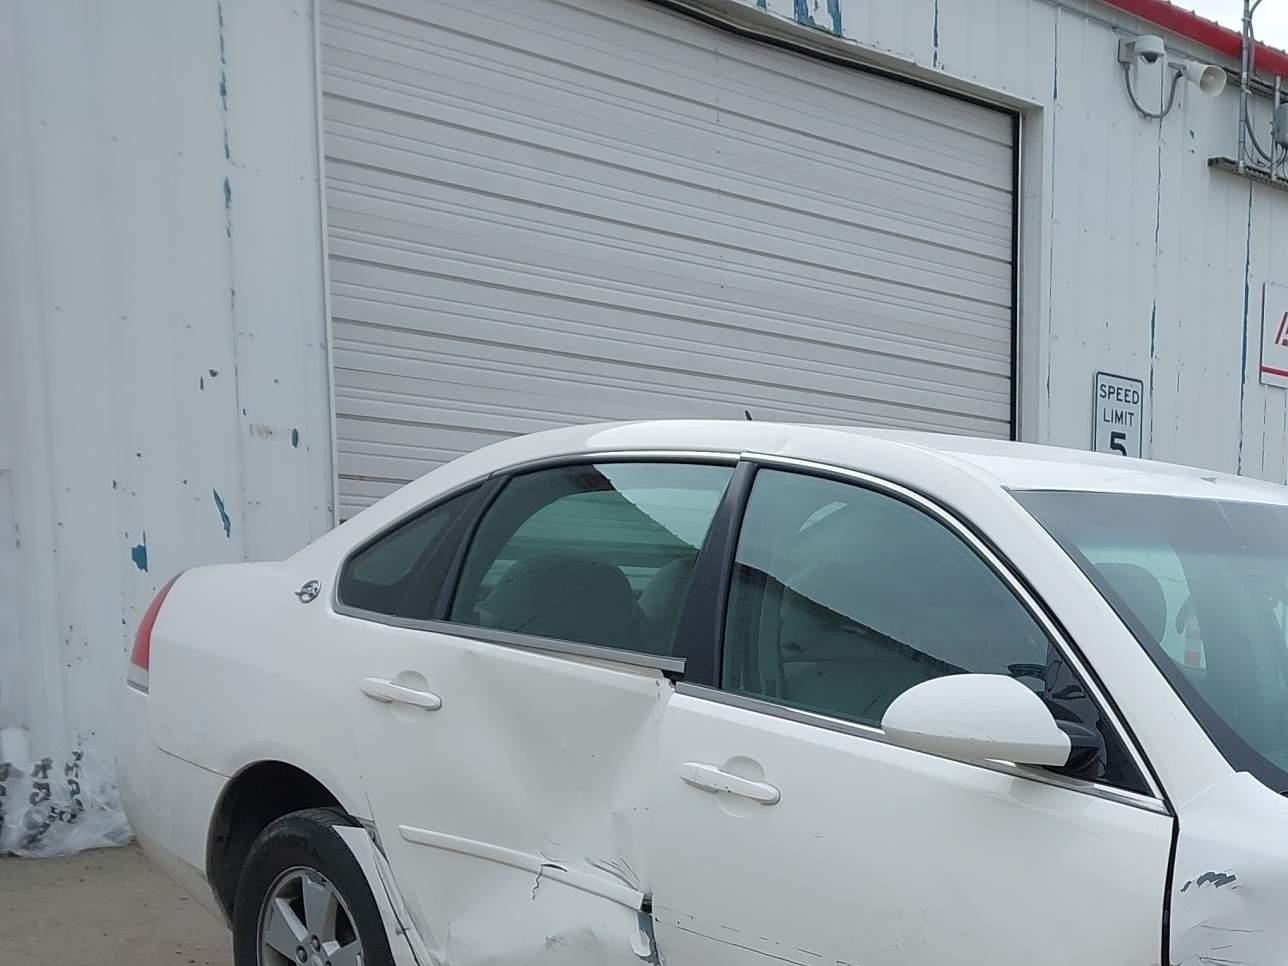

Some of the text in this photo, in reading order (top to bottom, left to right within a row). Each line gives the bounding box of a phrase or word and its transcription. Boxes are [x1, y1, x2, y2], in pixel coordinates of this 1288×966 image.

[1100, 383, 1140, 404] SPEED
[1103, 407, 1135, 426] LIMIT
[1110, 430, 1127, 456] 5
